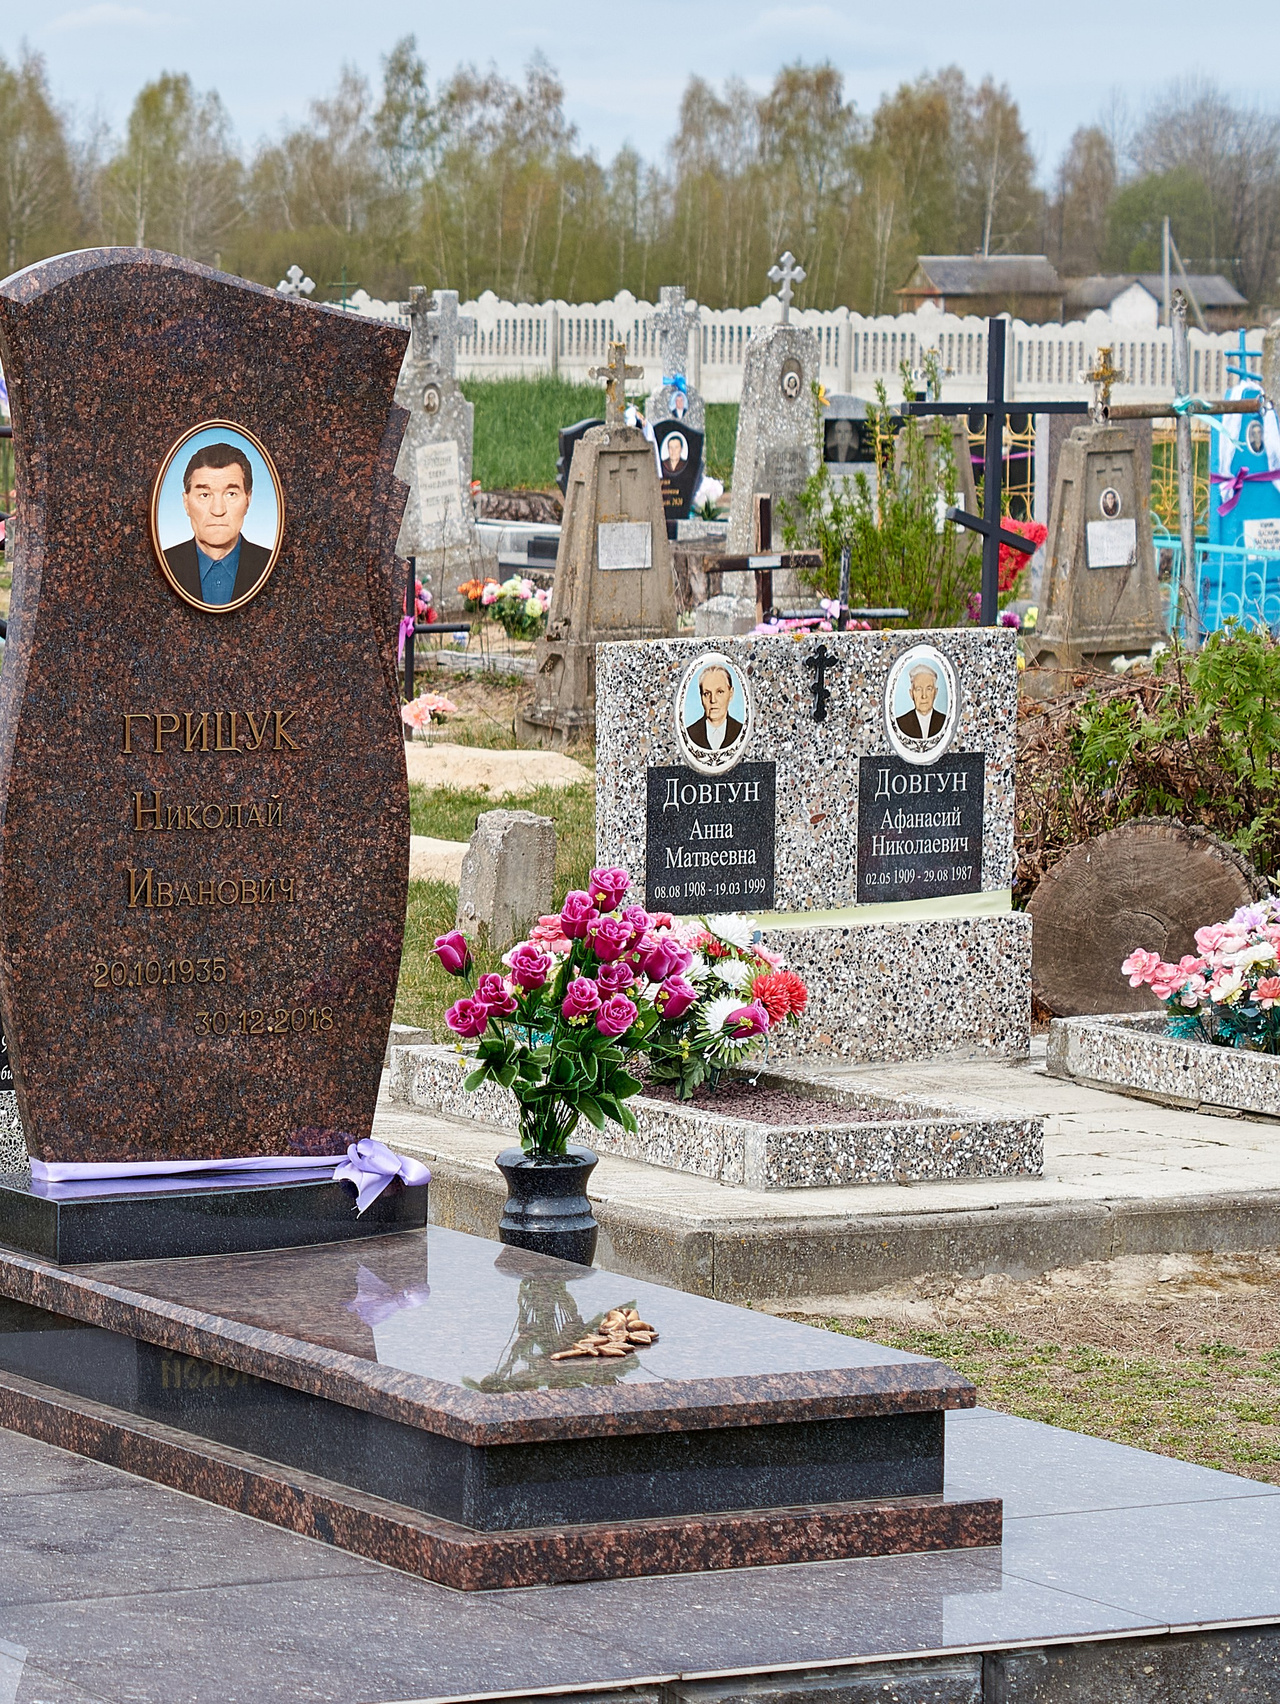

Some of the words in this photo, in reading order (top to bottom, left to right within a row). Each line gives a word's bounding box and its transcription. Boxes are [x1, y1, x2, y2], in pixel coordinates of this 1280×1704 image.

[122, 710, 302, 754] ГРИЦУК
[689, 818, 734, 841] Анна
[880, 806, 962, 834] Афанасий
[665, 845, 757, 870] Матвеевна
[871, 835, 970, 857] Николаевич
[865, 872, 891, 885] 02.05
[894, 867, 916, 884] 1909
[923, 869, 949, 883] 29.08
[951, 865, 973, 881] 1987
[654, 885, 681, 899] 08.08
[684, 881, 706, 898] 1908
[715, 882, 741, 896] 19.03
[743, 878, 766, 894] 1999
[93, 957, 228, 989] 20.10.1935
[194, 1007, 335, 1037] 30.12.2018
